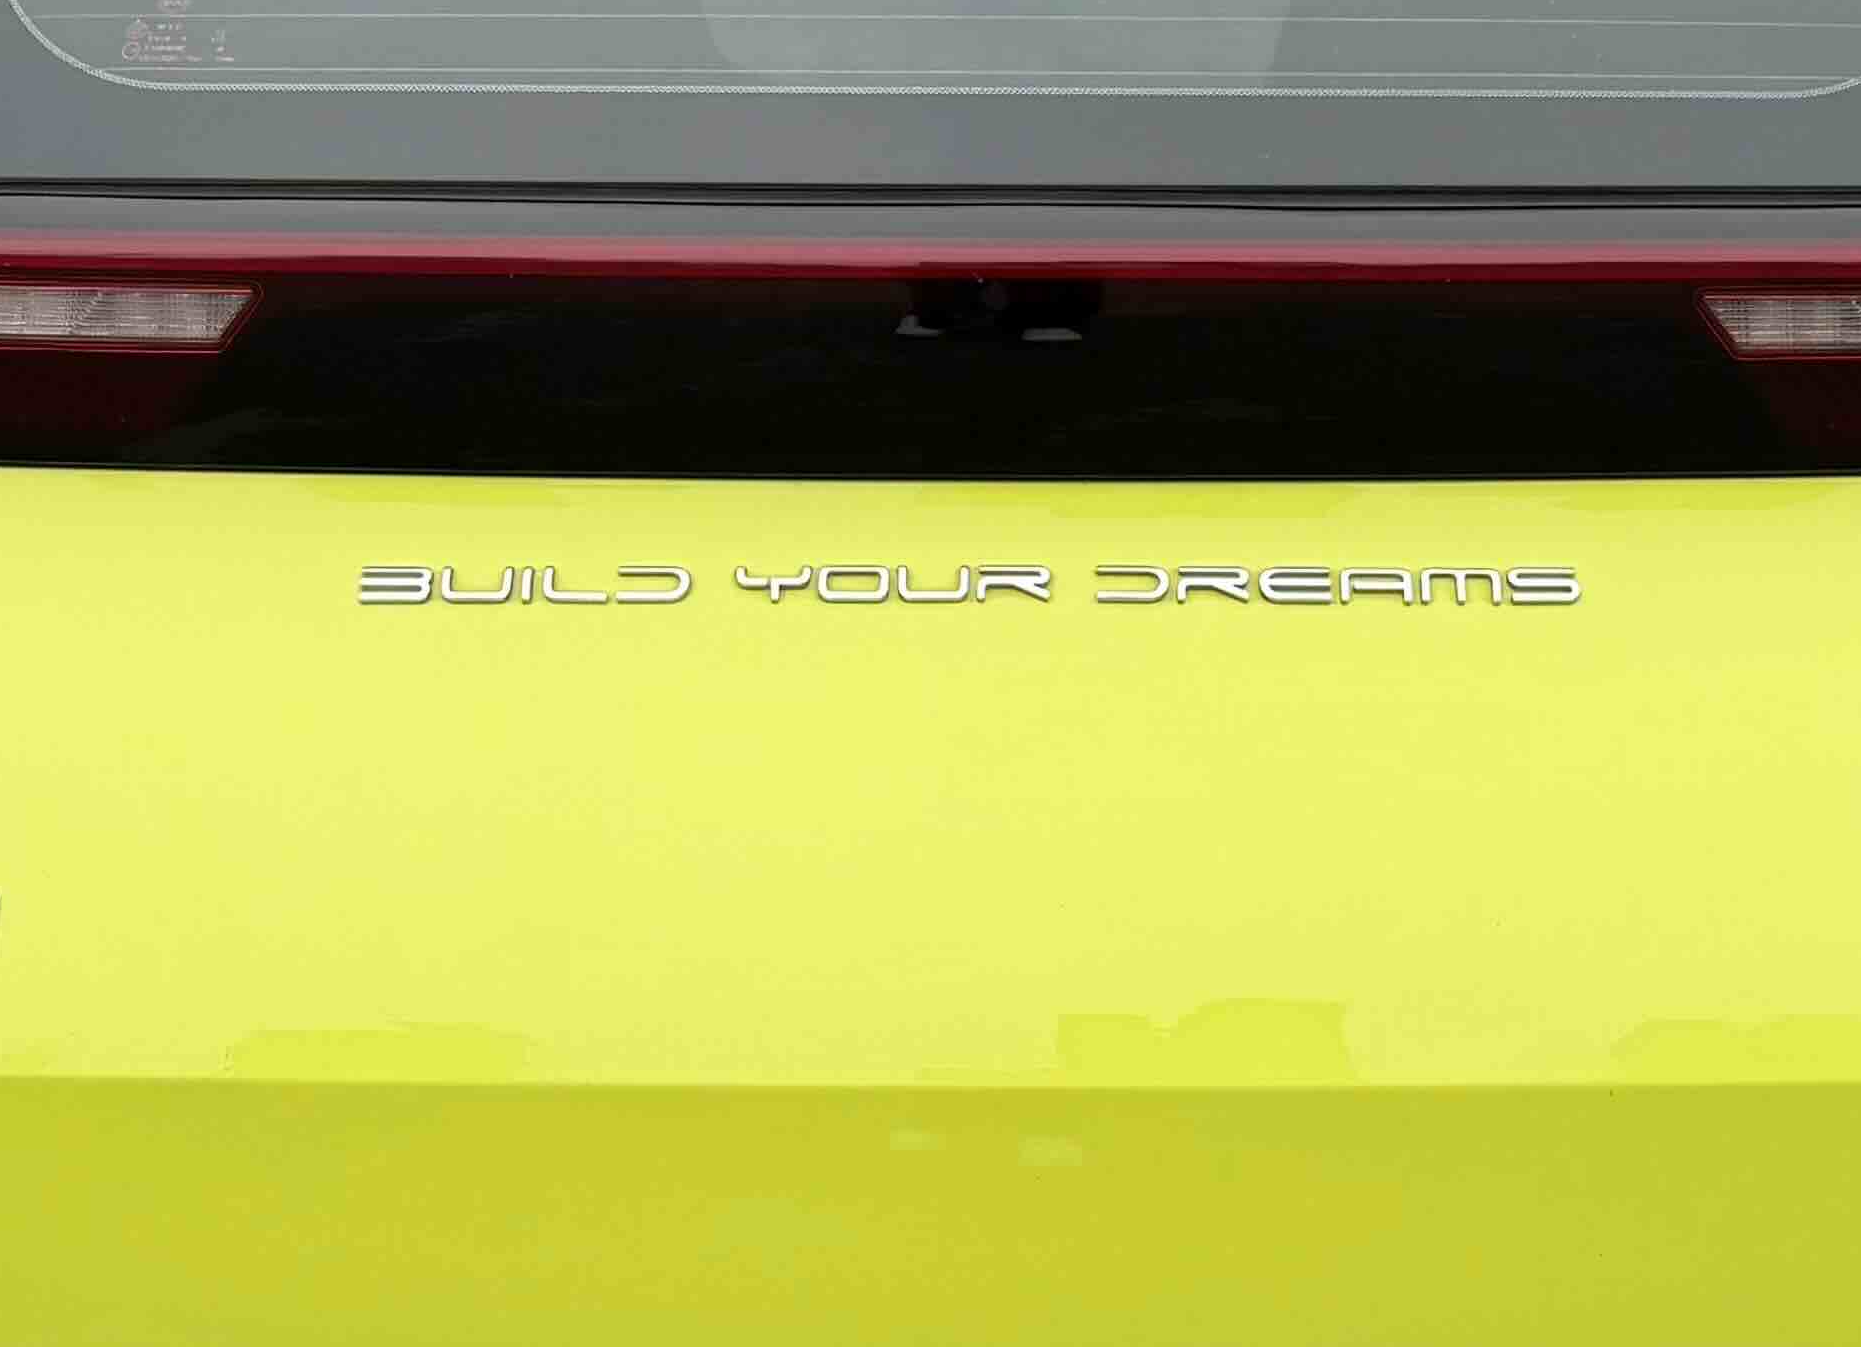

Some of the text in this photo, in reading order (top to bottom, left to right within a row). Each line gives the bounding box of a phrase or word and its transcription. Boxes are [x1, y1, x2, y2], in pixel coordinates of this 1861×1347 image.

[357, 564, 1583, 606] BUILD YOUR DREAMS
